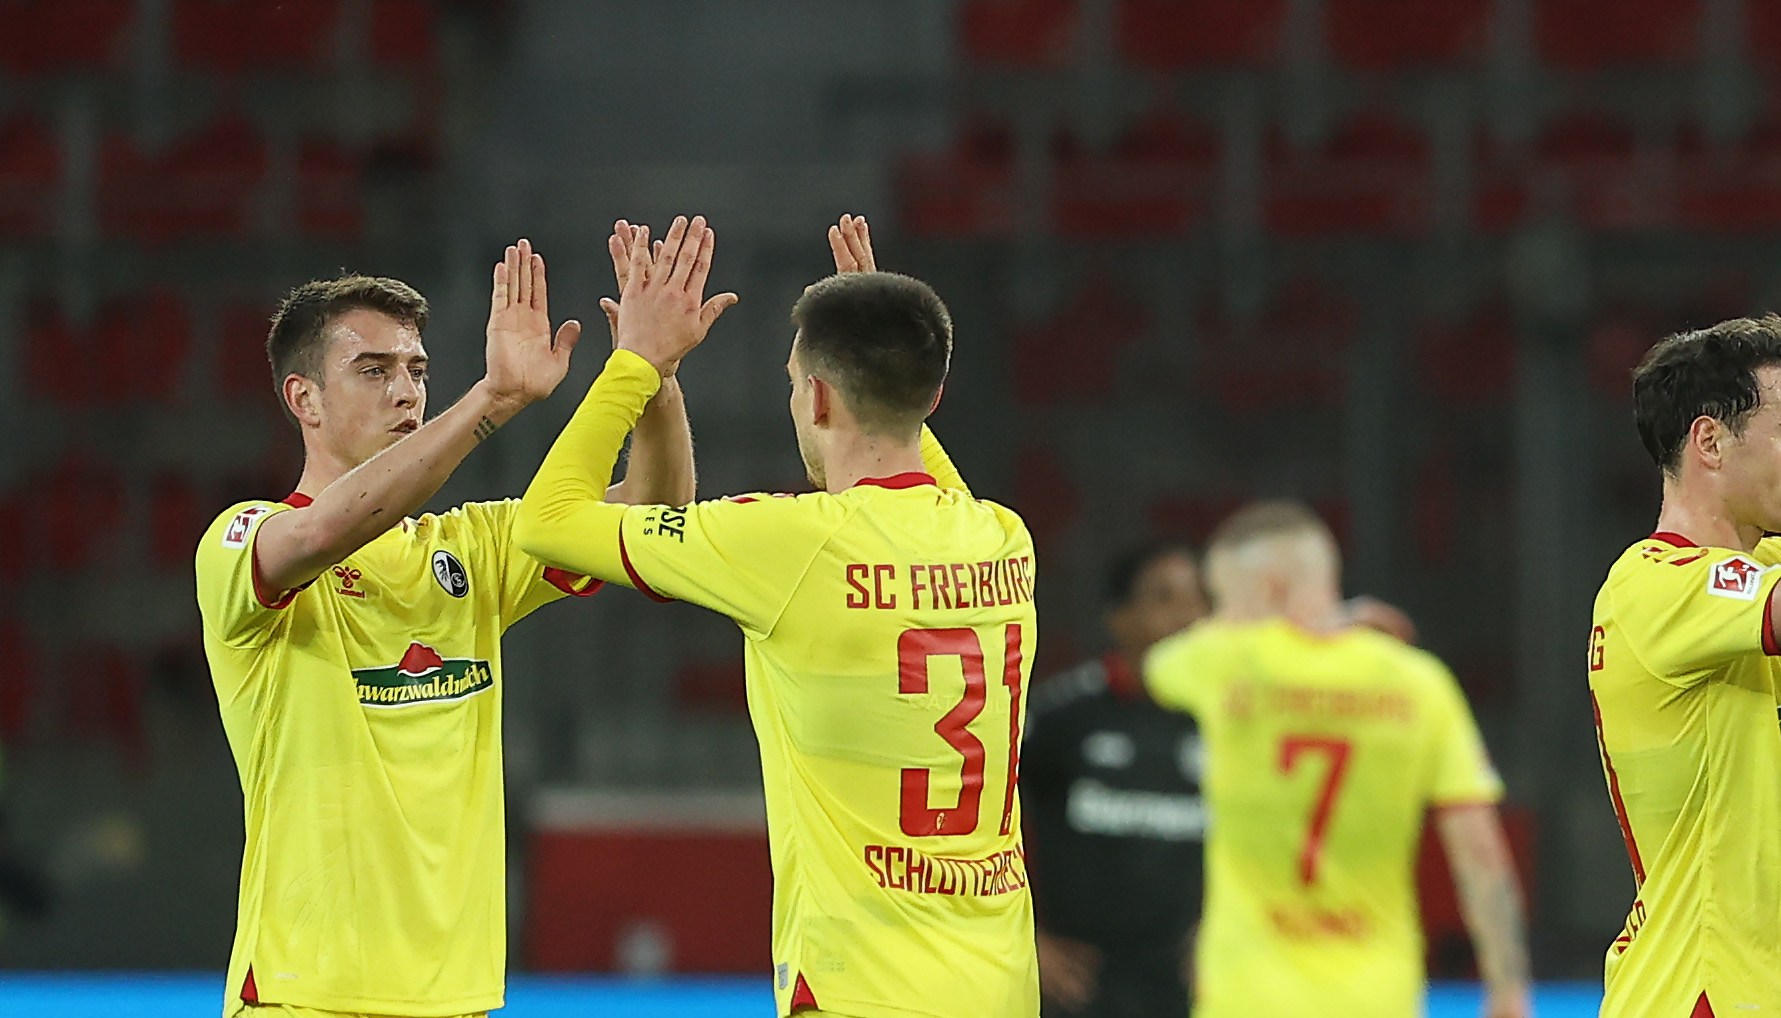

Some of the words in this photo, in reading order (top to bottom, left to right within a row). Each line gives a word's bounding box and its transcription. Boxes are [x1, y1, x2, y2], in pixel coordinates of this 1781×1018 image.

[846, 564, 896, 610] SC
[897, 623, 1022, 837] 31
[1277, 733, 1353, 885] 7
